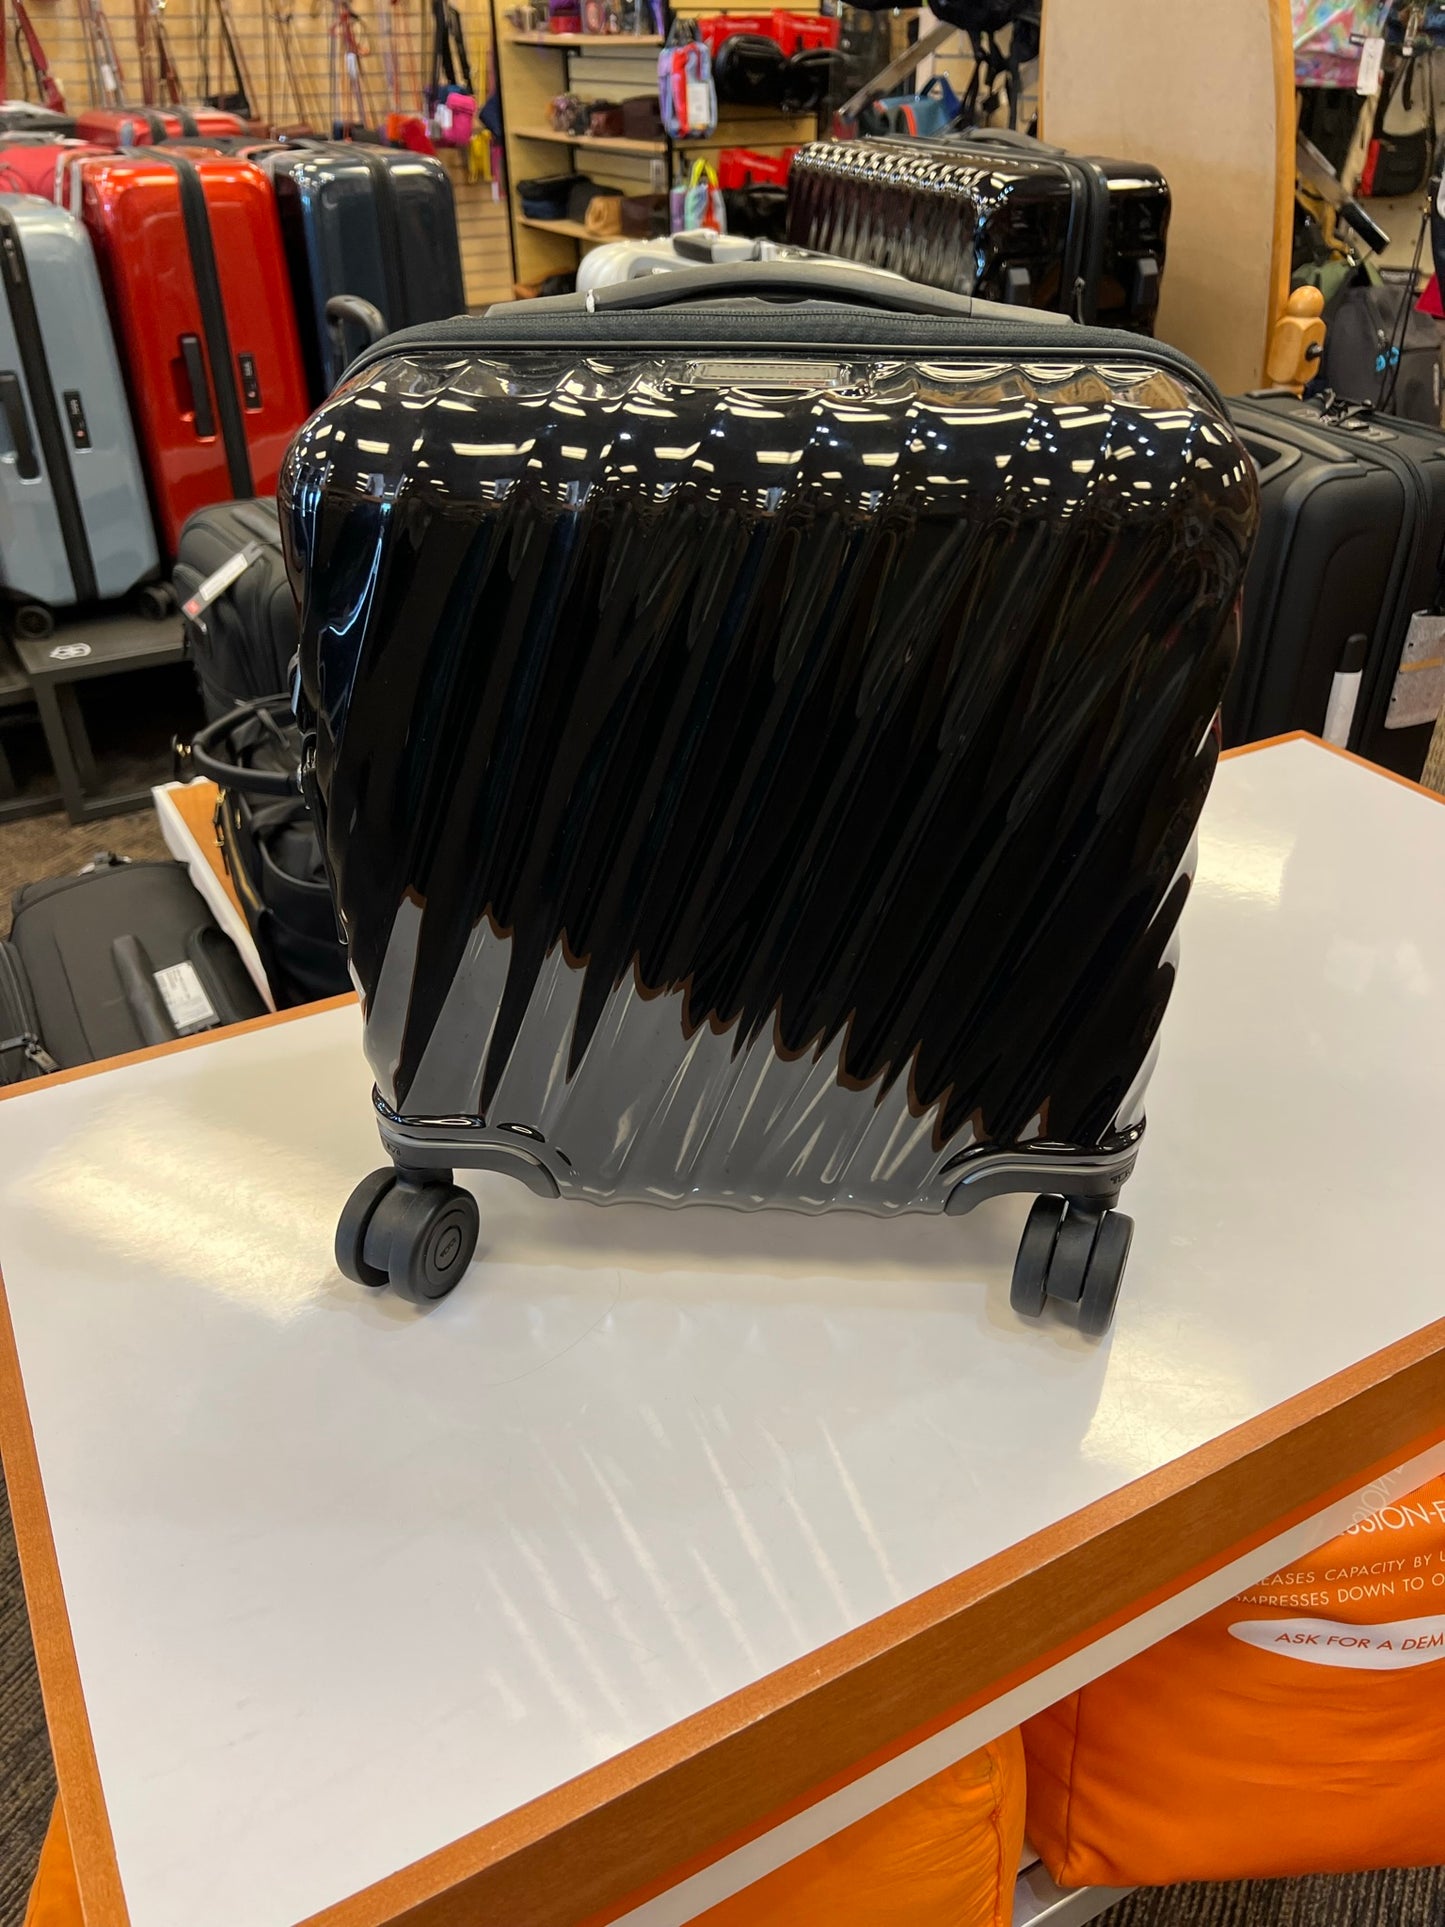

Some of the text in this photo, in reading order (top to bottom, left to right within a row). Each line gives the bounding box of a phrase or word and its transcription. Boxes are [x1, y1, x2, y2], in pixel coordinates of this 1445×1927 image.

[1256, 1571, 1315, 1586] EASES
[1325, 1558, 1406, 1581] CAPACITY
[1413, 1553, 1432, 1569] BY
[1337, 1581, 1395, 1603] DOWN
[1402, 1576, 1424, 1592] TO
[1274, 1631, 1444, 1651] ASK FOR A DEM
